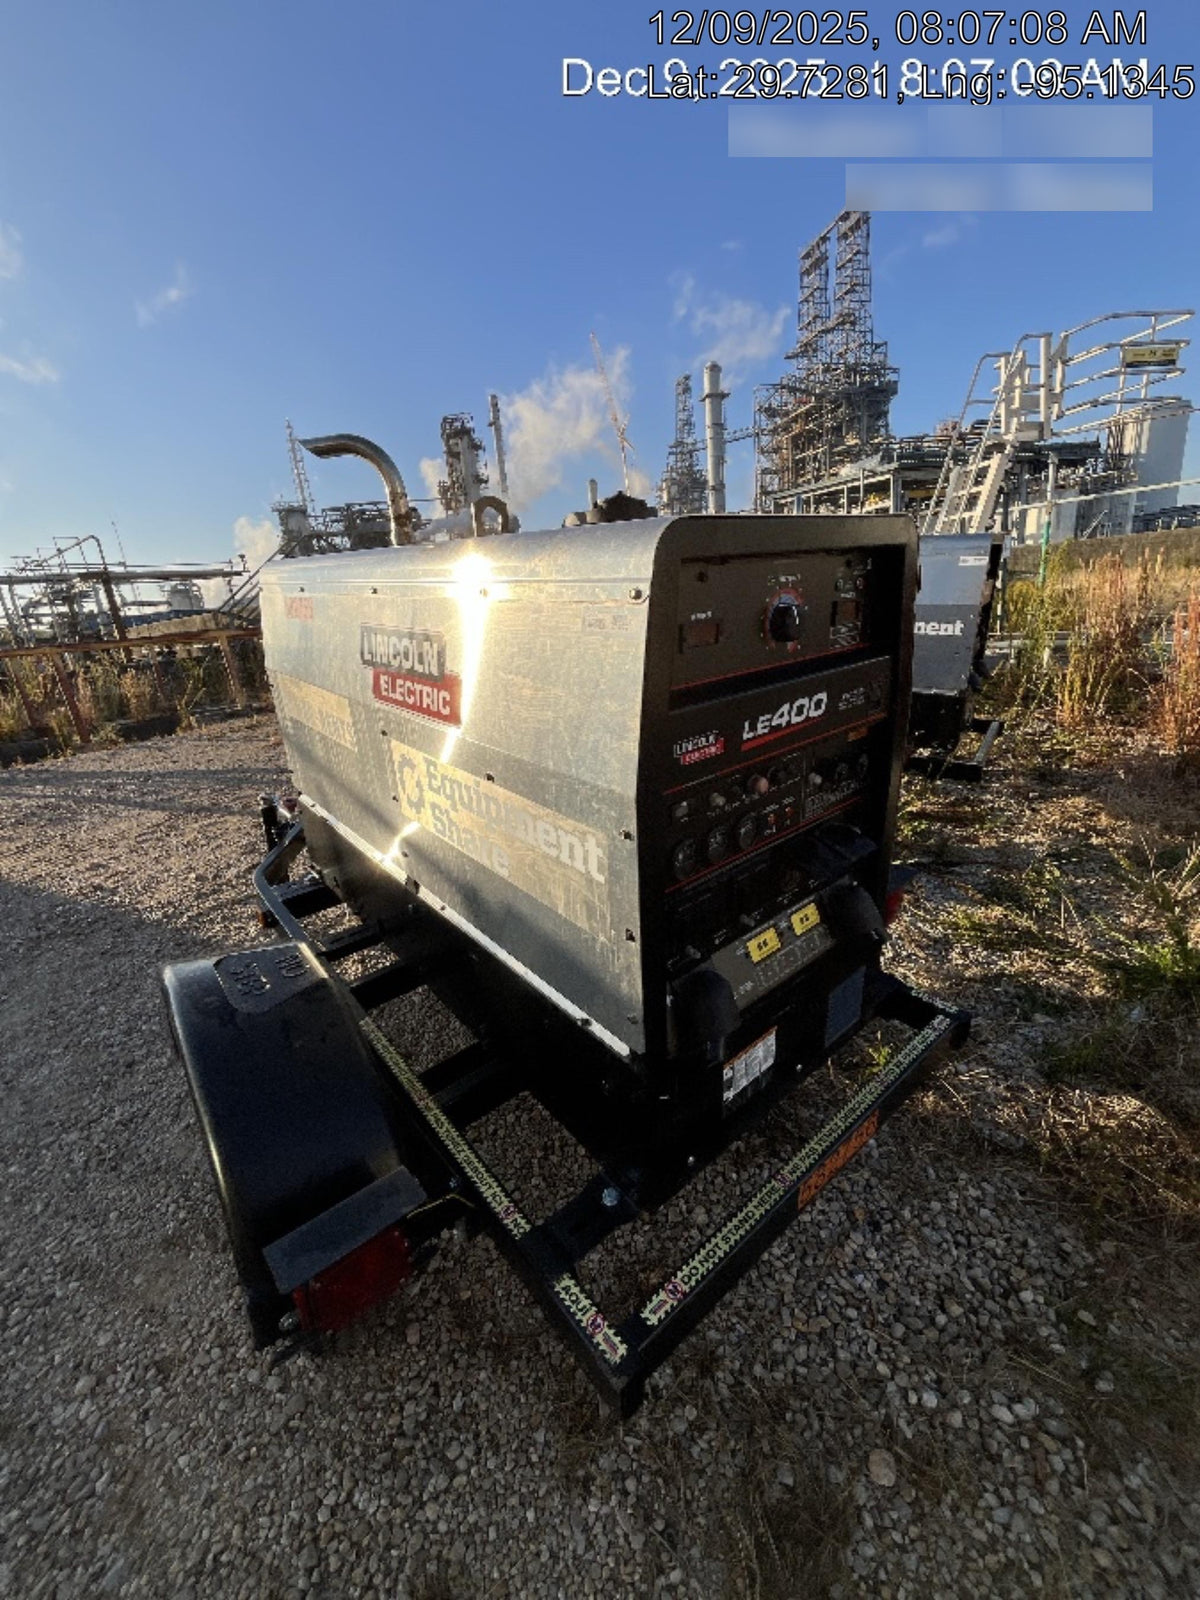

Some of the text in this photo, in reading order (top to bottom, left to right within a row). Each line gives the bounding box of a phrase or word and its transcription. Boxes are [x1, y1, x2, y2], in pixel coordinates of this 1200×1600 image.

[363, 632, 439, 676] LINCOLN
[380, 674, 451, 716] ELECTRIC
[742, 691, 828, 741] LE400
[679, 1182, 782, 1285] DO NOT STAND HERE
[560, 1282, 590, 1316] AQUI
